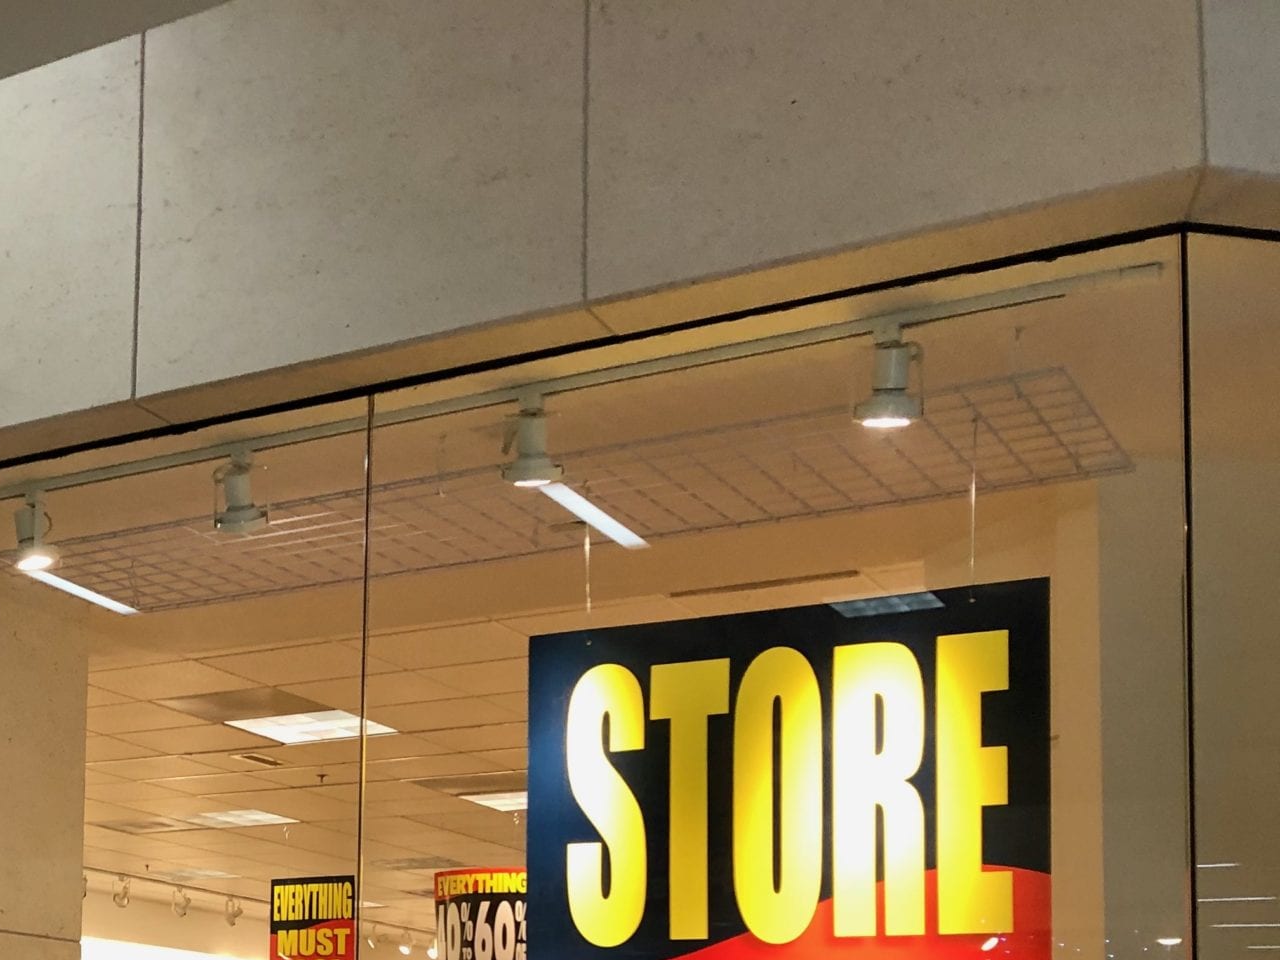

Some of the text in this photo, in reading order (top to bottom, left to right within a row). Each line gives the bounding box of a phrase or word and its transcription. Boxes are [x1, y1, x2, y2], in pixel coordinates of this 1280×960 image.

[566, 629, 1015, 948] STORE
[273, 881, 353, 922] EVERYTHING
[438, 872, 527, 897] EVERYTHING
[277, 928, 350, 957] MUST
